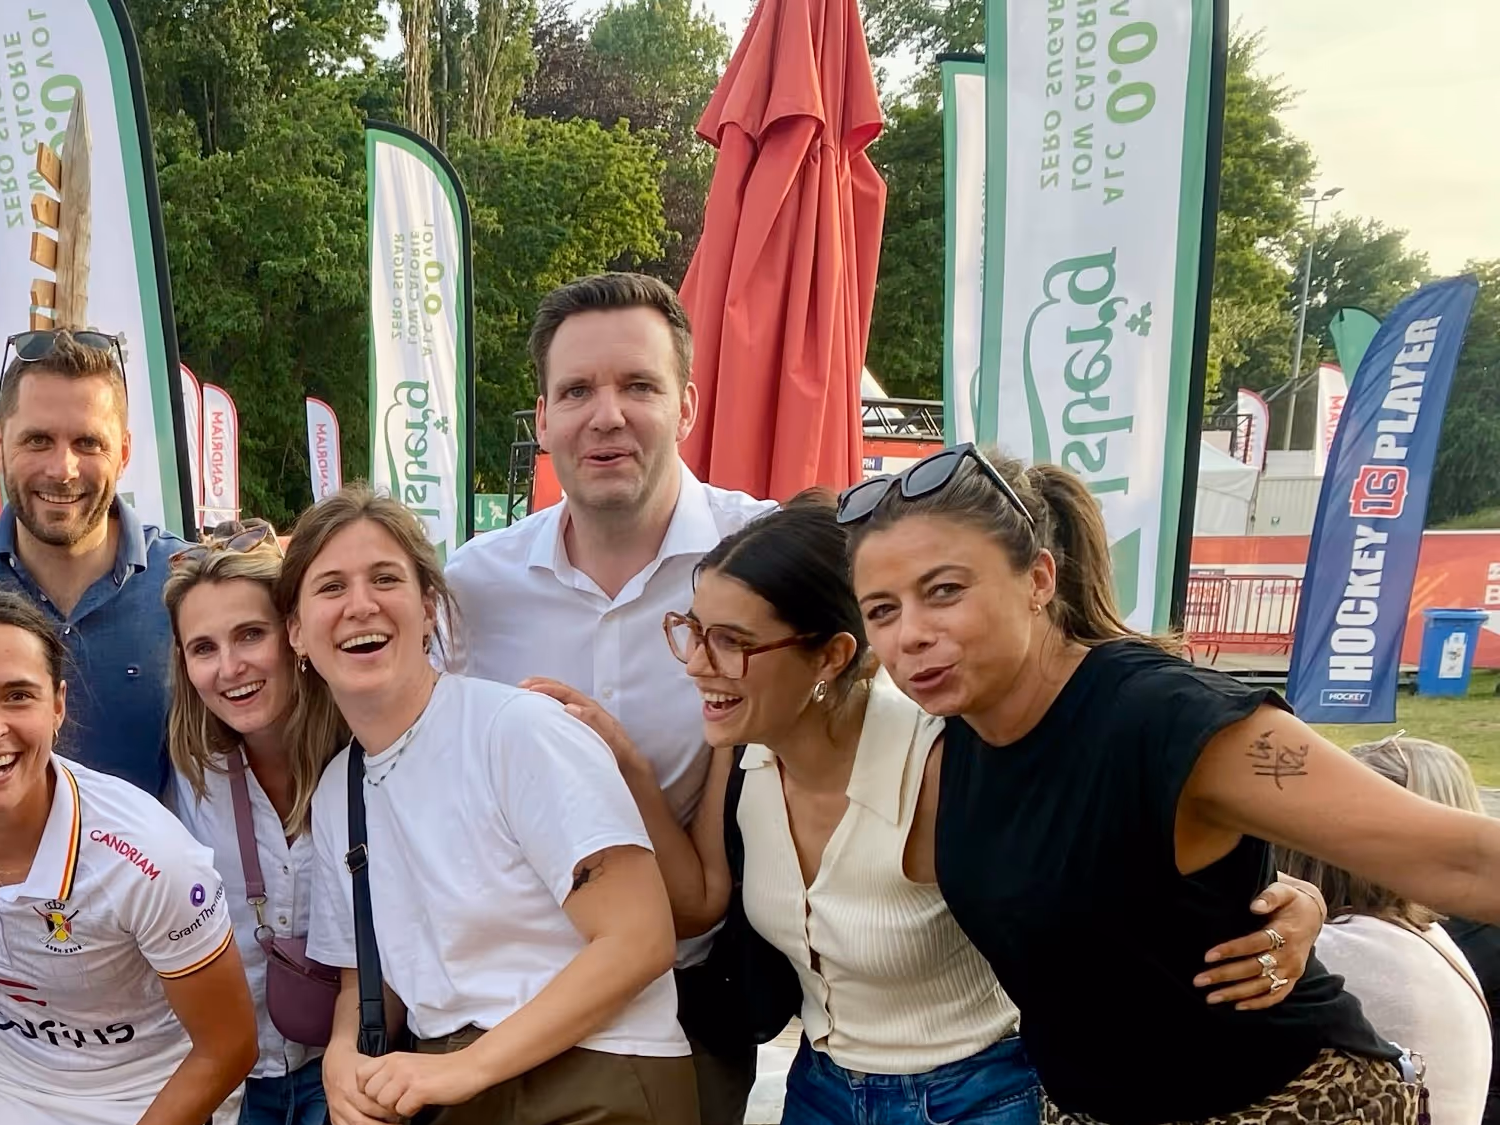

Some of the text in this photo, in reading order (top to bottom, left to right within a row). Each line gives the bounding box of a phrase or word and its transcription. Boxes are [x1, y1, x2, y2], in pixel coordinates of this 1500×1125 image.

[1329, 524, 1388, 681] HOCKEY
[1373, 315, 1443, 460] PLAYER
[1328, 693, 1365, 702] HOCKEY
[90, 829, 161, 881] CANDRIAM
[168, 918, 202, 941] Grant
